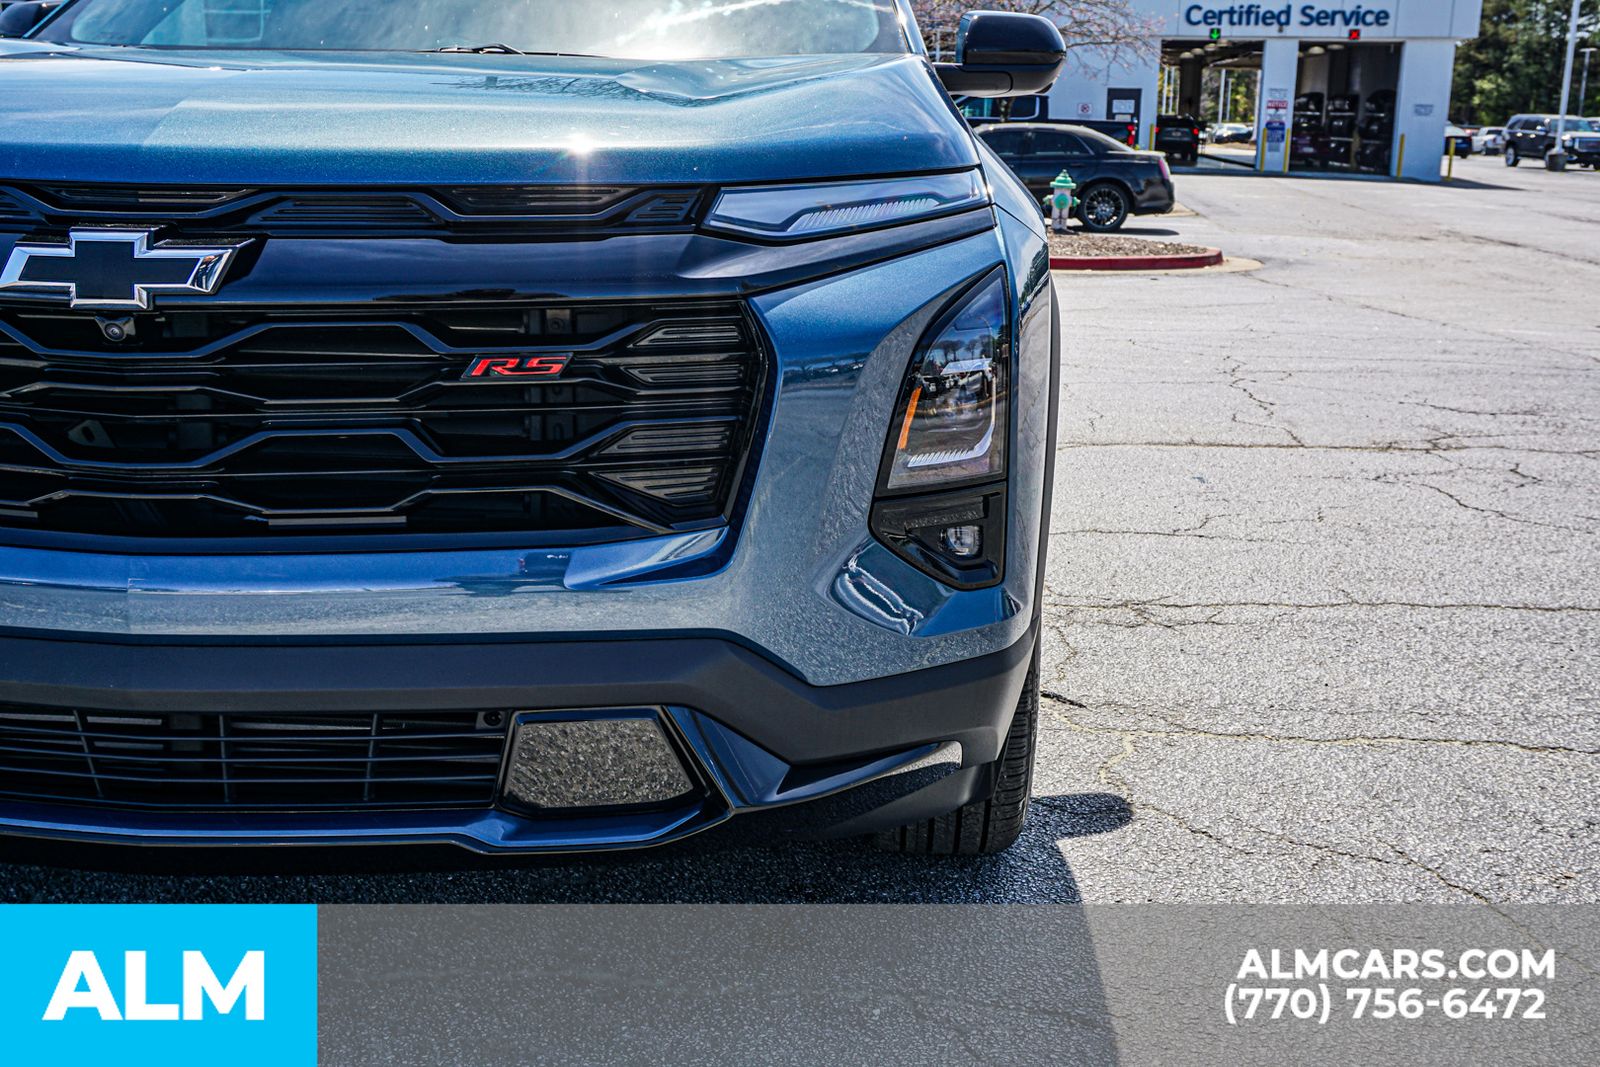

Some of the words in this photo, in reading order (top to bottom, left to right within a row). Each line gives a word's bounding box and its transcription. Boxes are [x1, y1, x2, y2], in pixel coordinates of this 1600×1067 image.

[1185, 4, 1292, 27] Certified
[1299, 5, 1390, 27] Service
[470, 356, 567, 376] RS
